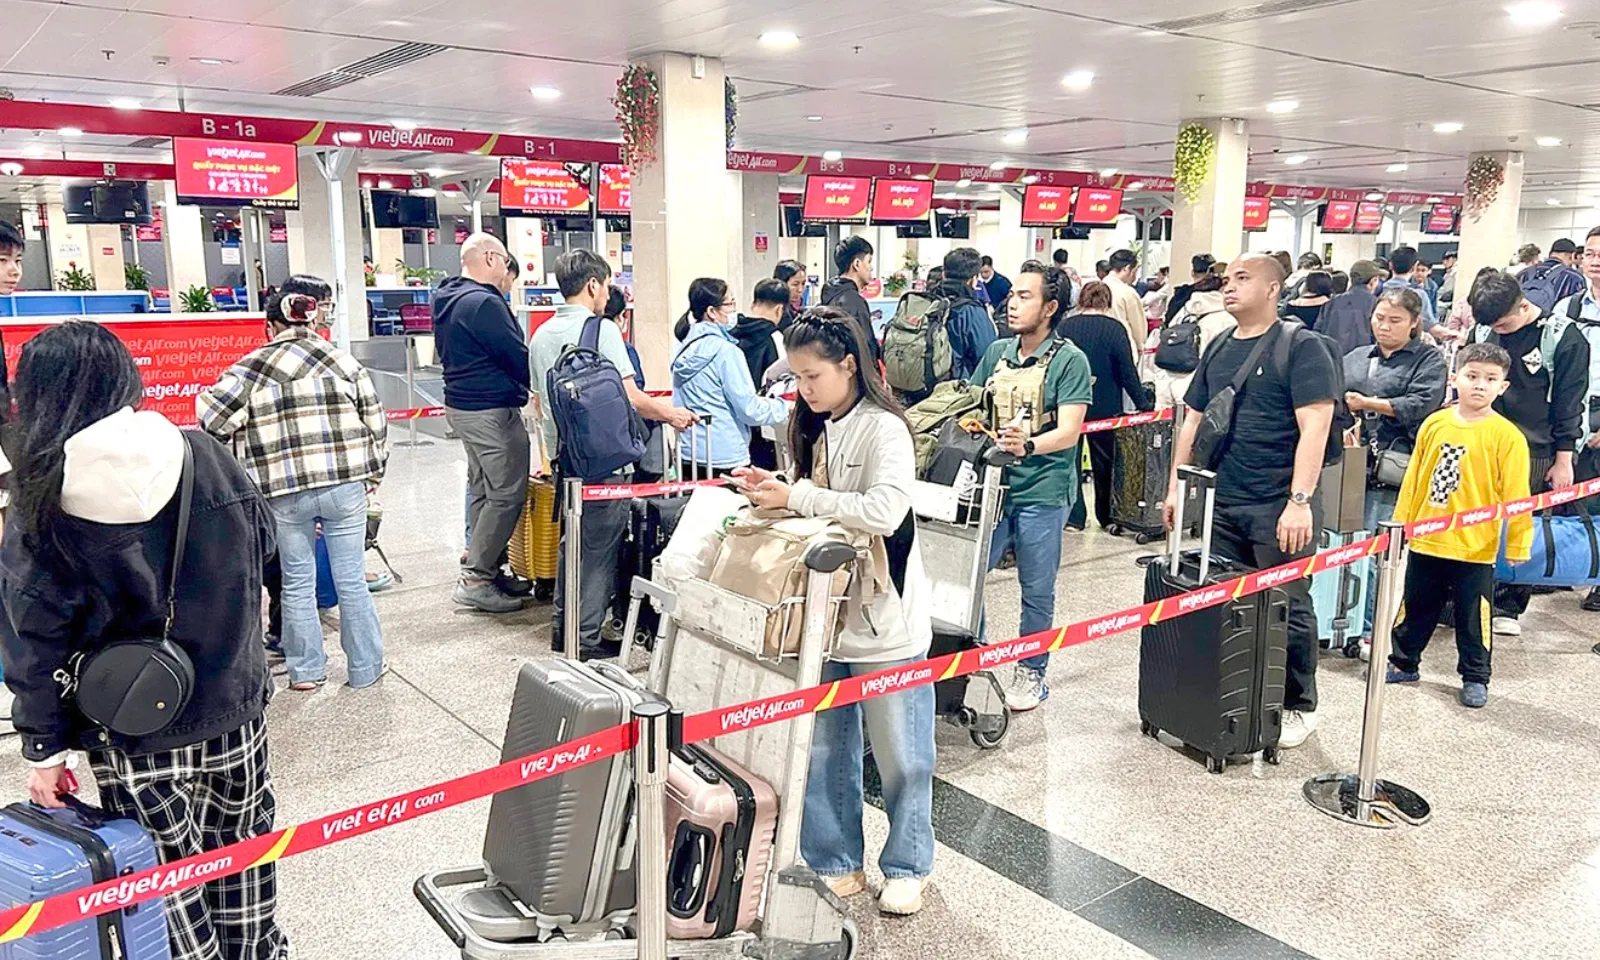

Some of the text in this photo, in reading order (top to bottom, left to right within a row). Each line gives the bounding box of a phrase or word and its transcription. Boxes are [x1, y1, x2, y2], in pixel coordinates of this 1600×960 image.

[202, 118, 216, 134] B
[234, 120, 256, 137] 1a
[525, 140, 534, 154] B
[548, 142, 555, 155] 1
